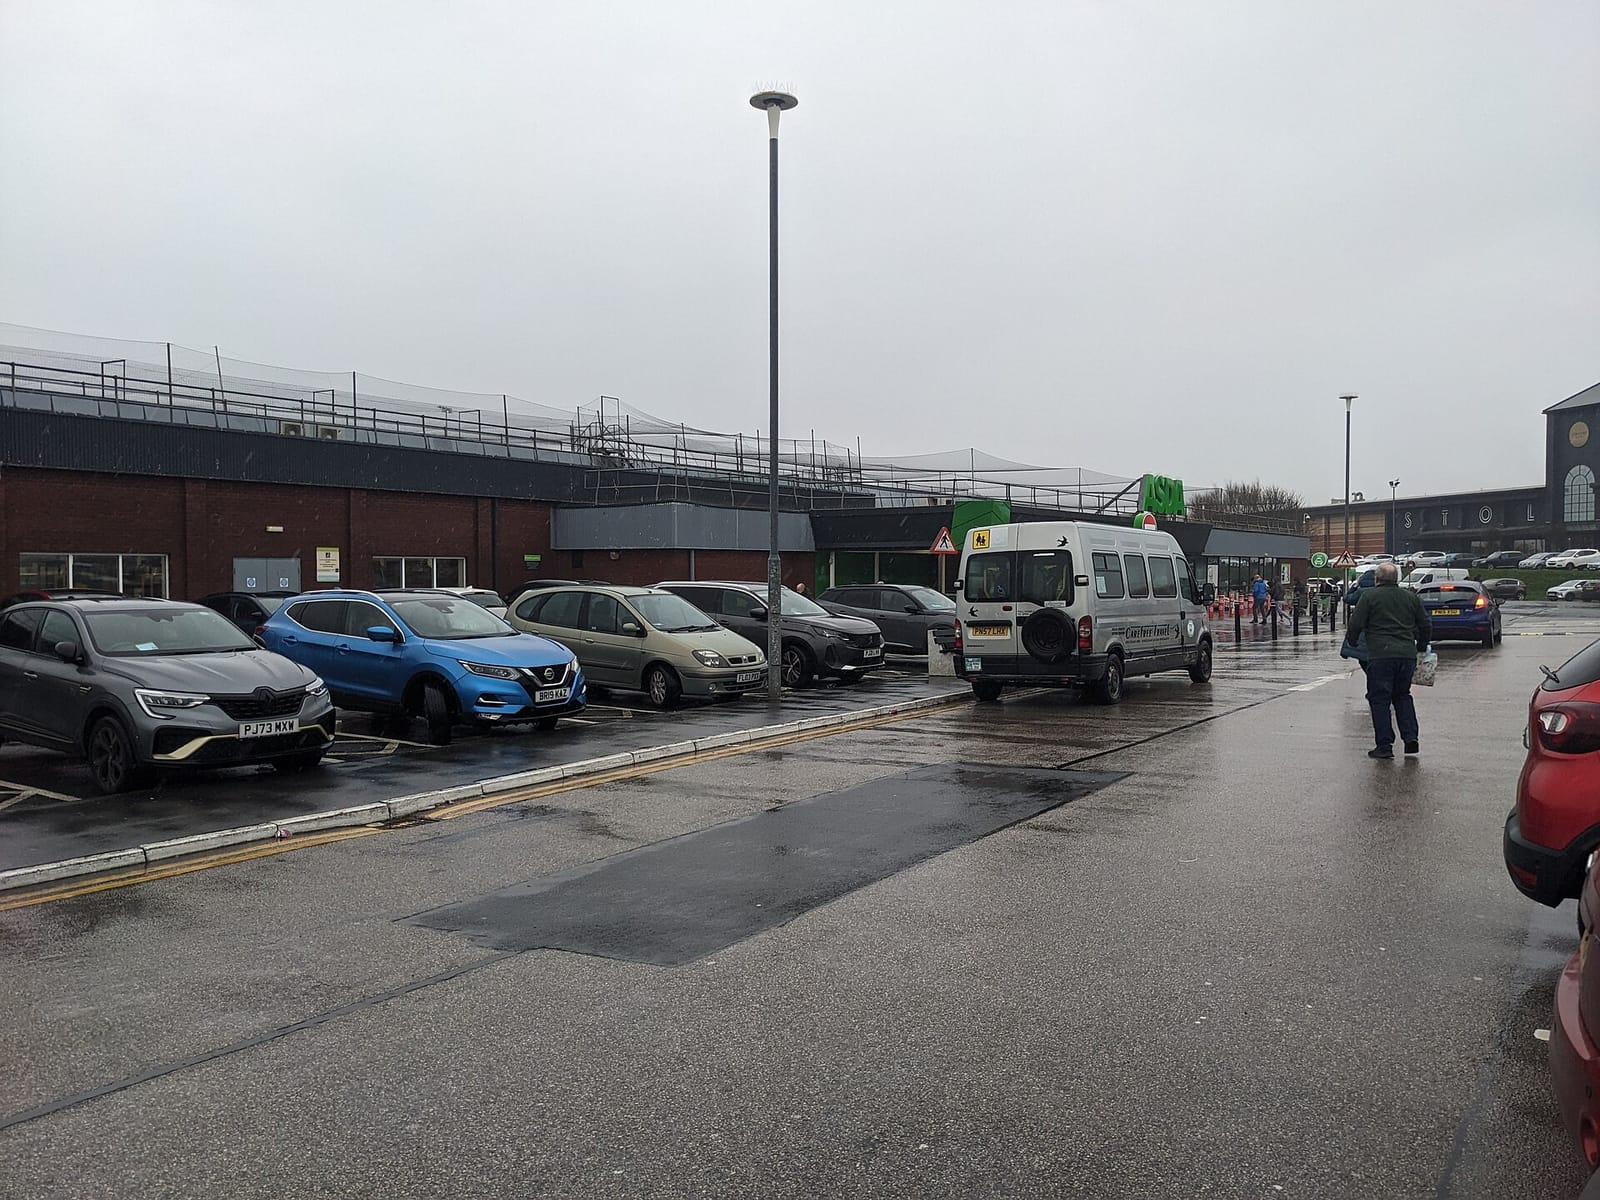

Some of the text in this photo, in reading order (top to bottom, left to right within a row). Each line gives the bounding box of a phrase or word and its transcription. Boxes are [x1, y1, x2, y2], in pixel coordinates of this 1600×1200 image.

[1140, 474, 1185, 515] ASDA
[539, 691, 554, 701] BR19
[244, 720, 295, 736] PJ73 MXW
